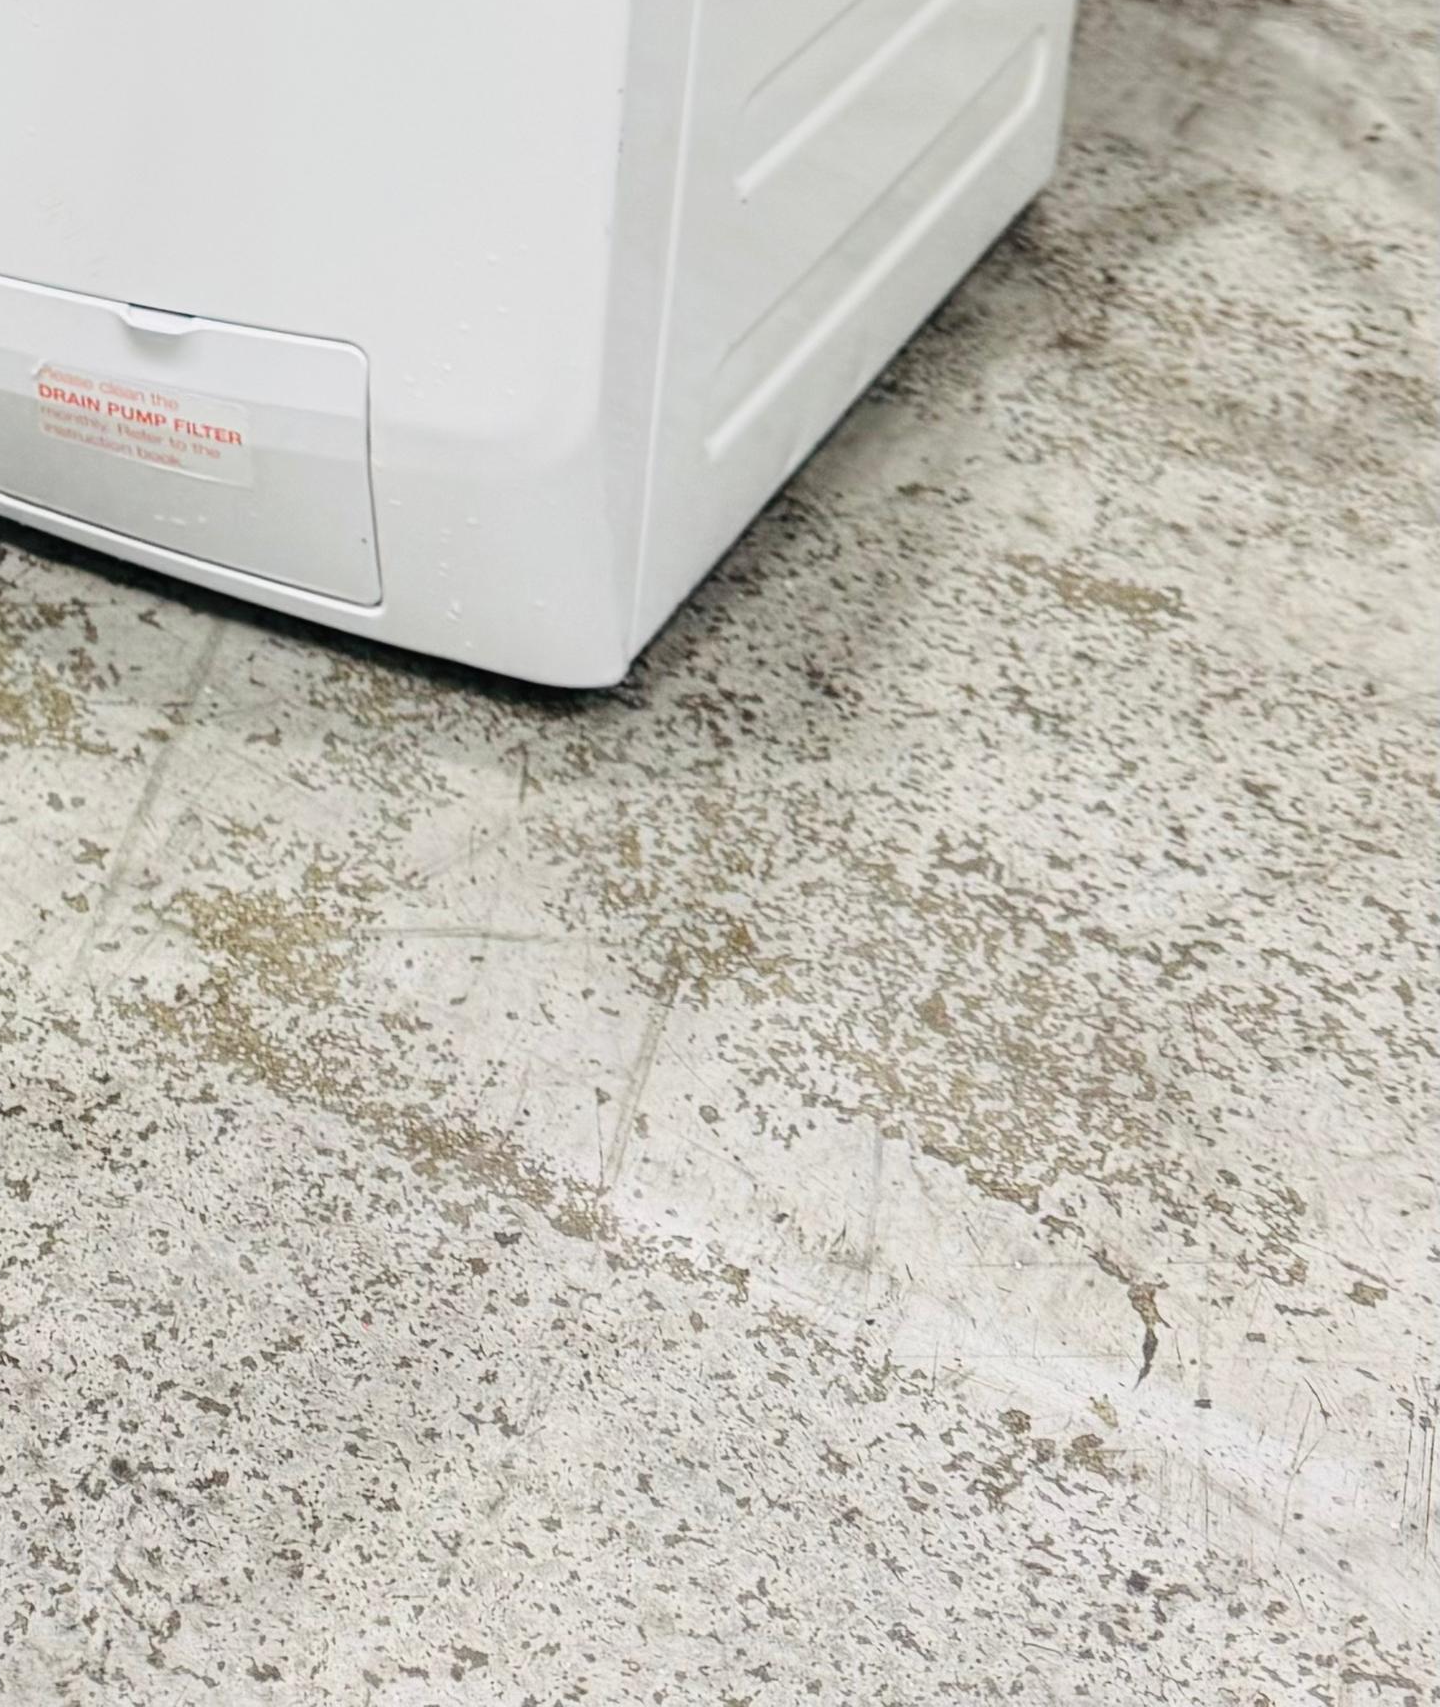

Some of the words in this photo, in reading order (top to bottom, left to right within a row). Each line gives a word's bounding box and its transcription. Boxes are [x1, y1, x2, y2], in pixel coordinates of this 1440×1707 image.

[39, 366, 94, 391] Please
[99, 381, 145, 402] clean
[150, 391, 179, 411] the
[38, 383, 100, 412] DRAIN
[108, 402, 167, 427] PUMP
[174, 417, 243, 447] FILTER
[44, 422, 133, 457] instruction
[117, 423, 162, 444] Refer
[170, 436, 187, 452] to
[192, 442, 221, 460] the
